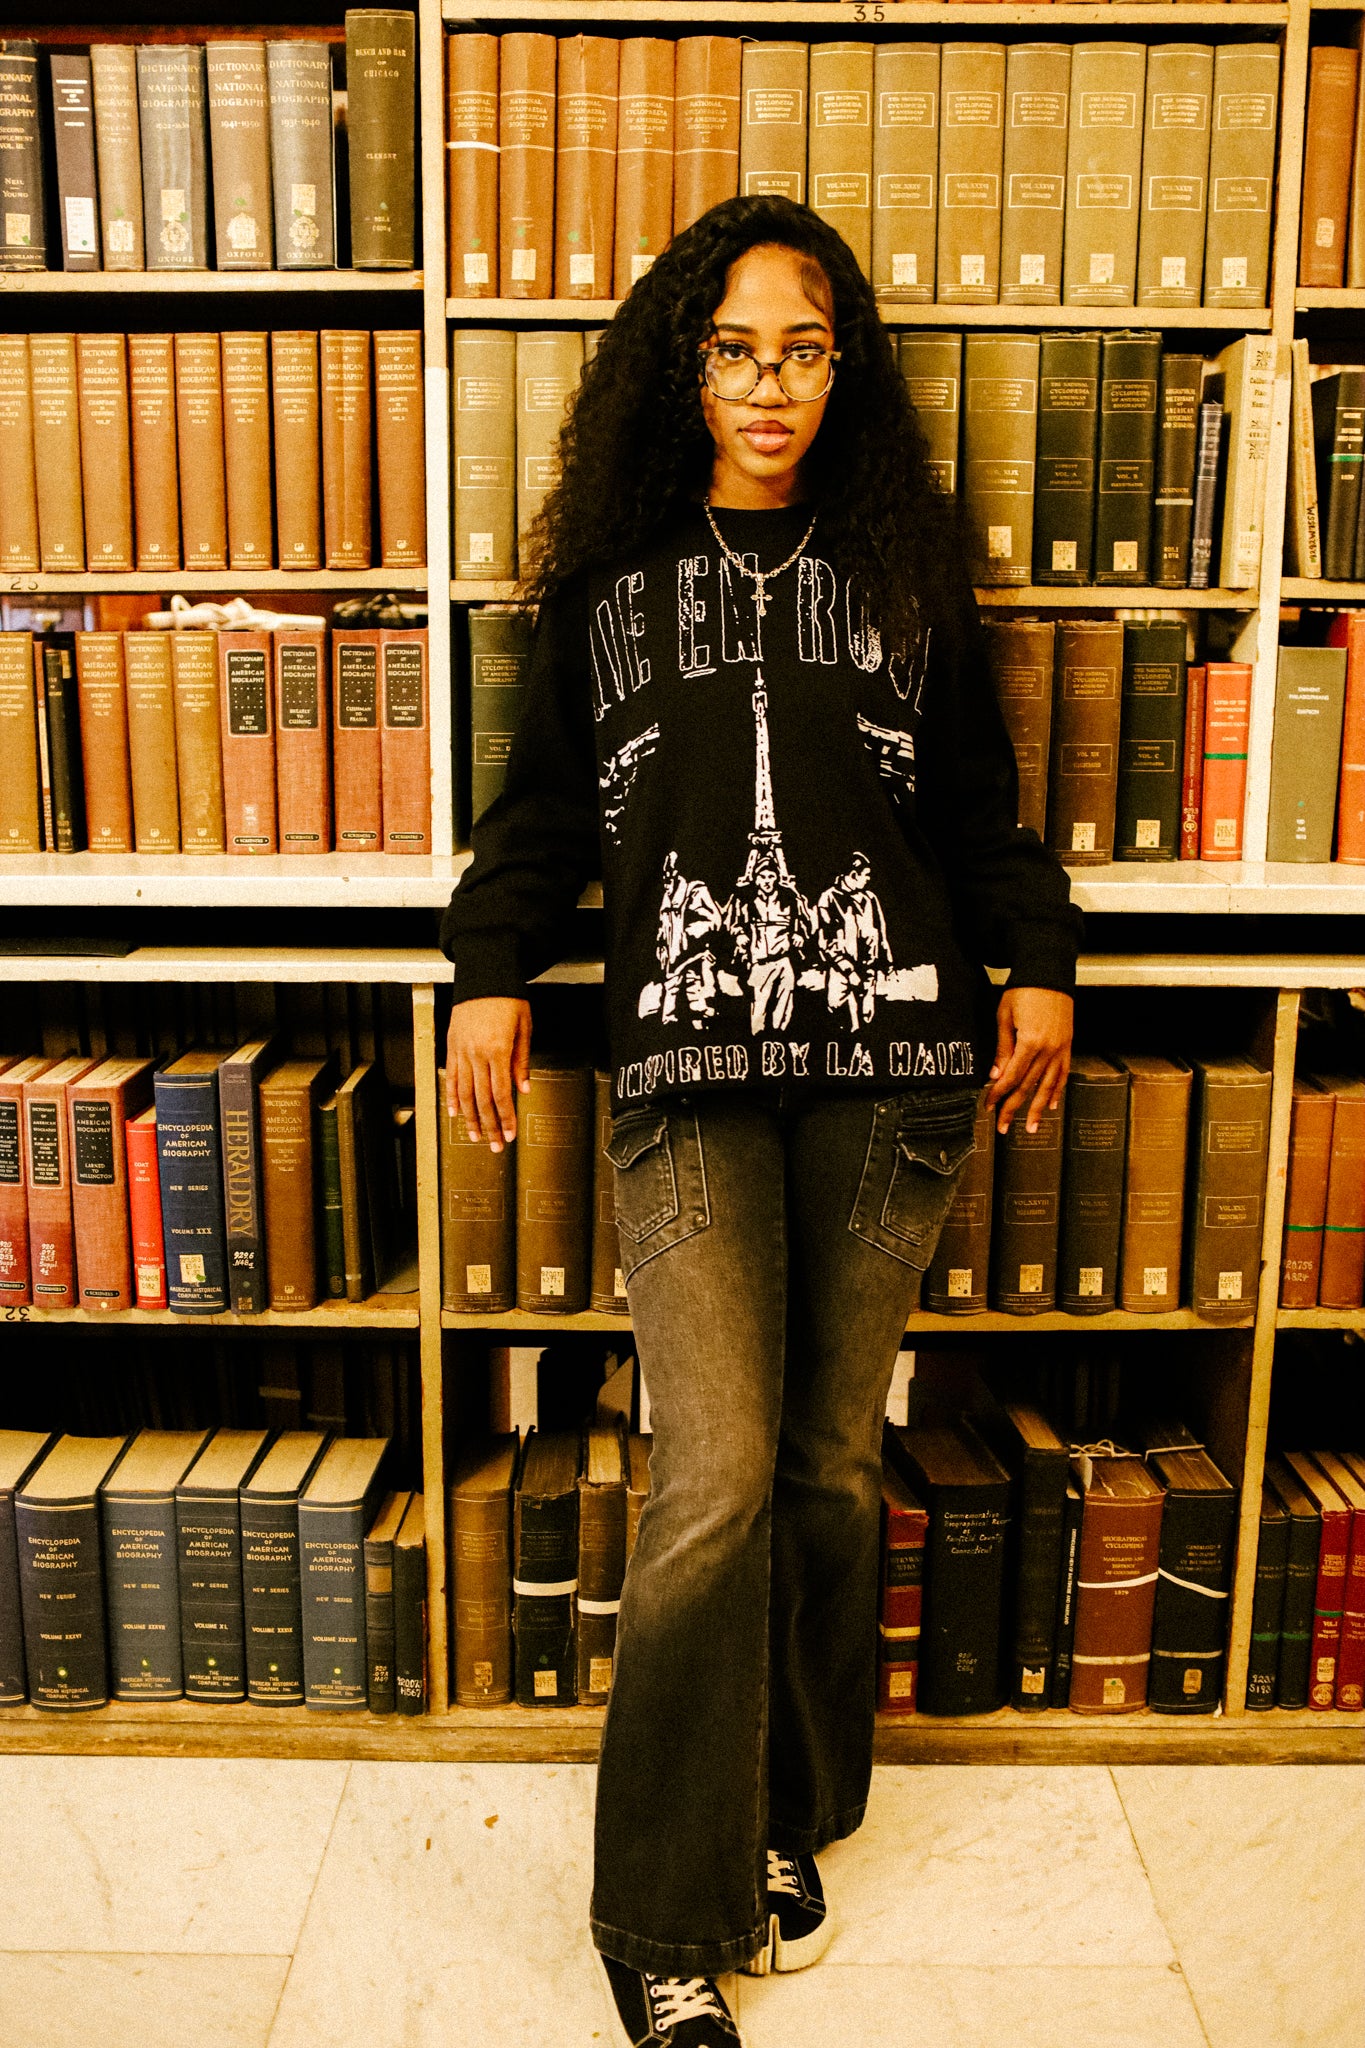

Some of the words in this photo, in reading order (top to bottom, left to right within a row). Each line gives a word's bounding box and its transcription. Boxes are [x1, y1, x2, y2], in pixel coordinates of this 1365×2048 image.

[854, 5, 885, 22] 35
[394, 49, 406, 57] BAR
[270, 60, 329, 69] DICTIONARY
[141, 65, 199, 73] DICTIONARY
[215, 83, 266, 92] NATIONAL
[276, 80, 328, 88] NATIONAL
[148, 85, 197, 93] NATIONAL
[271, 96, 329, 104] BIOGRAPHY
[618, 1045, 748, 1098] INSPIRED
[762, 1041, 810, 1077] BY
[827, 1042, 874, 1077] LA
[889, 1042, 974, 1077] HAINE
[158, 1124, 213, 1132] ENCYCLOPEDIA
[225, 1110, 250, 1237] HERALDRY
[112, 1529, 165, 1537] ENCYCLOPEDIA
[28, 1537, 80, 1545] ENCYCLOPEDIA
